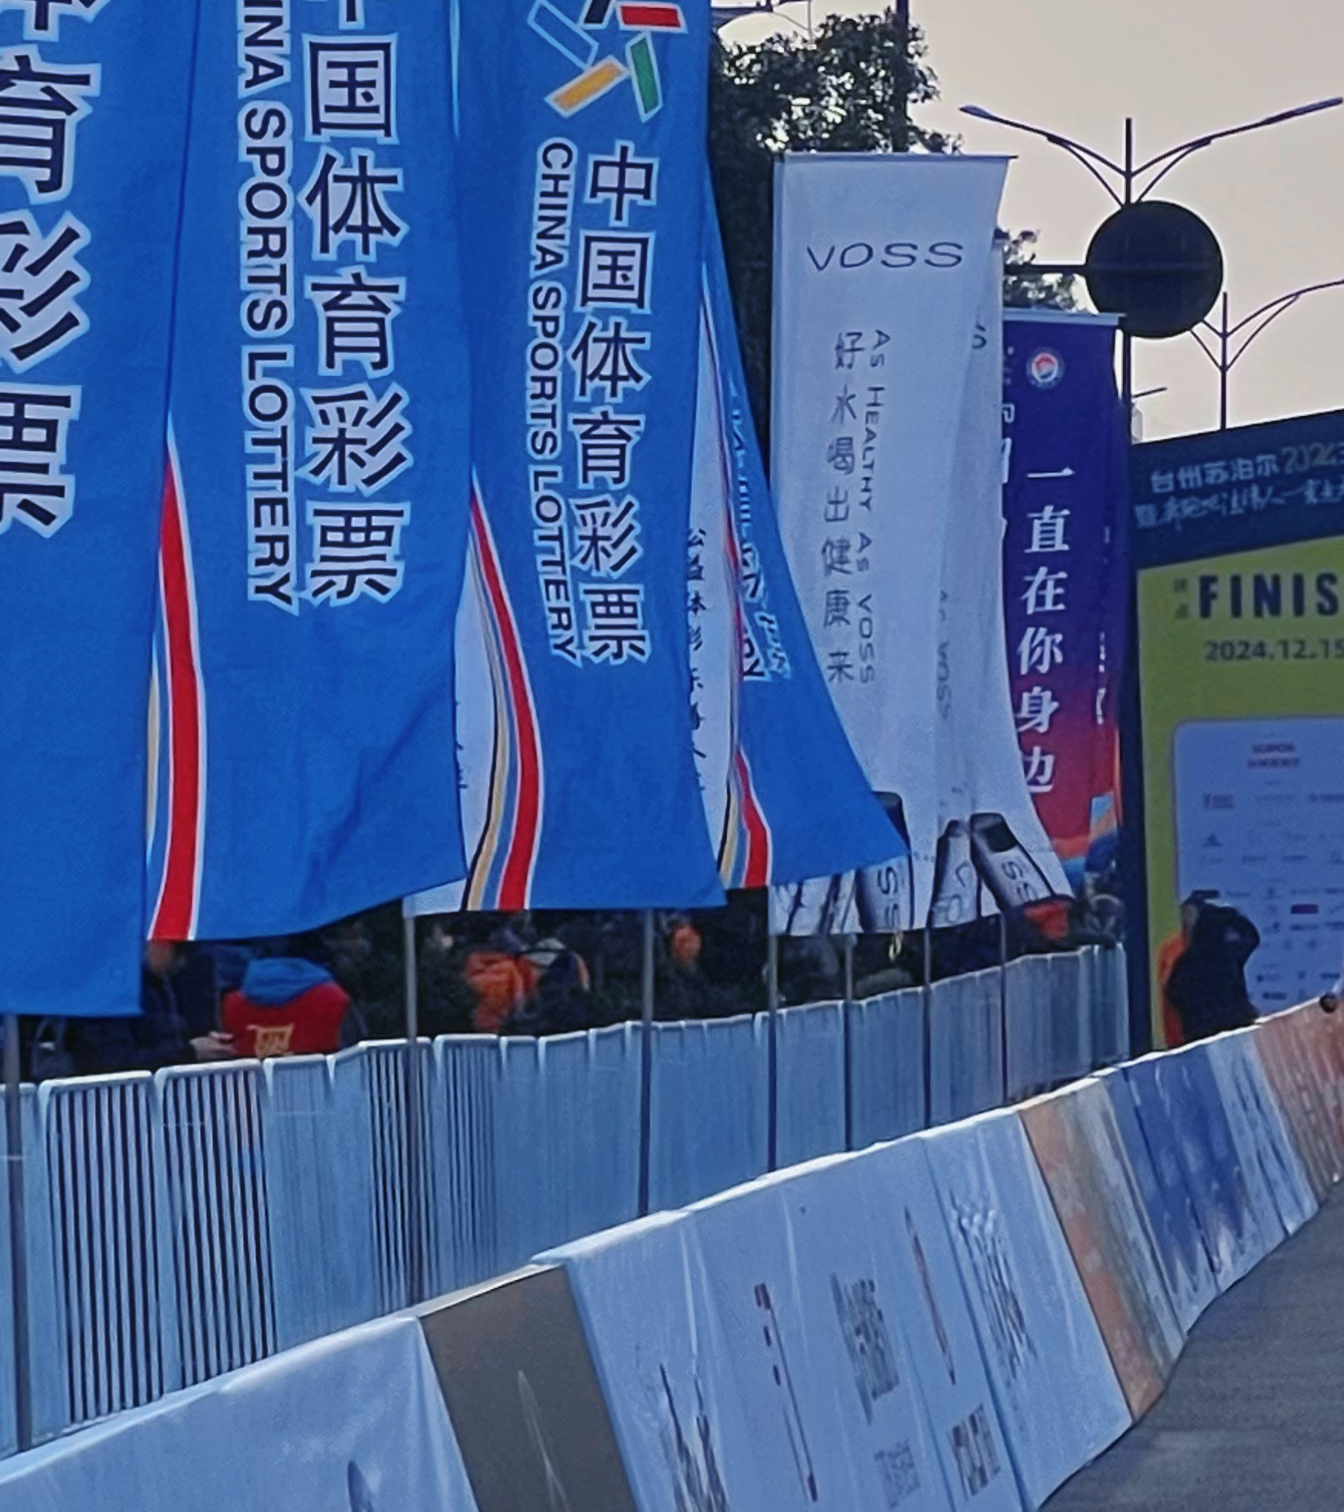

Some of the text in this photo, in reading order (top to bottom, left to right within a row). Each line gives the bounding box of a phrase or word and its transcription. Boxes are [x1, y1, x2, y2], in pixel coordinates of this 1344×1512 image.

[245, 110, 290, 333] SPORTS
[806, 239, 964, 272] VOSS
[245, 345, 296, 610] LOTTERY
[526, 140, 578, 664] CHINA SPORTS LOTTERY
[570, 142, 658, 664] 中国体育彩票
[822, 330, 866, 685] 好水喝出健康来
[858, 386, 887, 512] HEALTHY
[856, 593, 876, 685] VOSS
[1016, 466, 1076, 794] 一直在你身边
